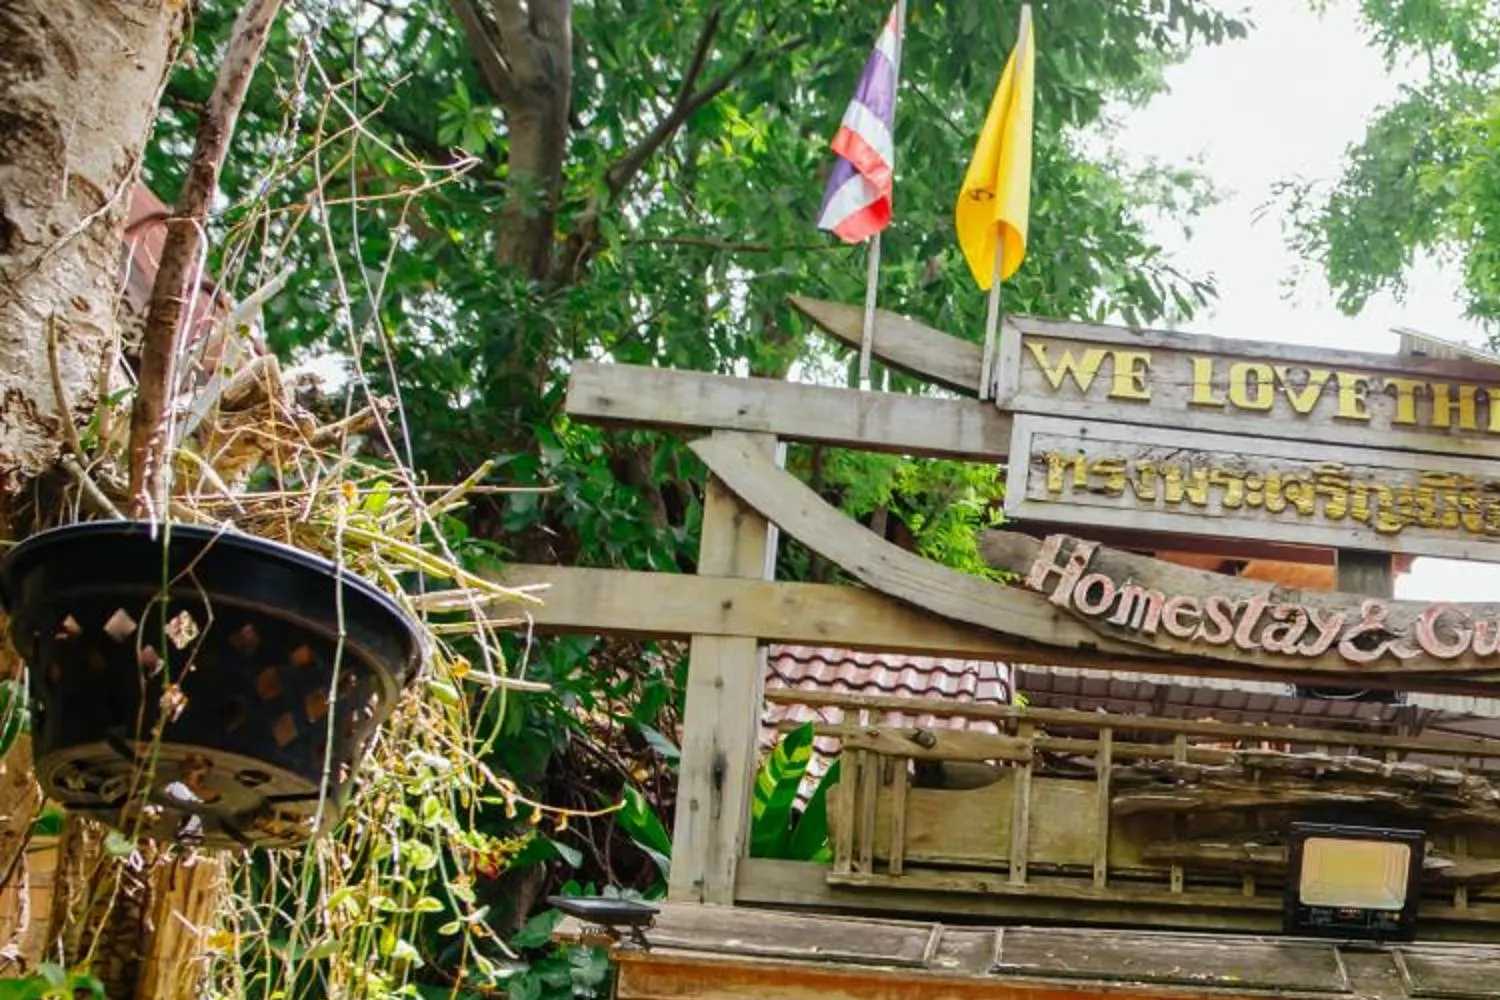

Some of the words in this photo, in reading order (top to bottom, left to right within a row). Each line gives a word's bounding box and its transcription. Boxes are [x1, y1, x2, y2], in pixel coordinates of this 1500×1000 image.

[1023, 341, 1152, 401] WE
[1187, 356, 1372, 424] LOVE
[1029, 533, 1349, 658] Homestay
[1338, 599, 1422, 663] &
